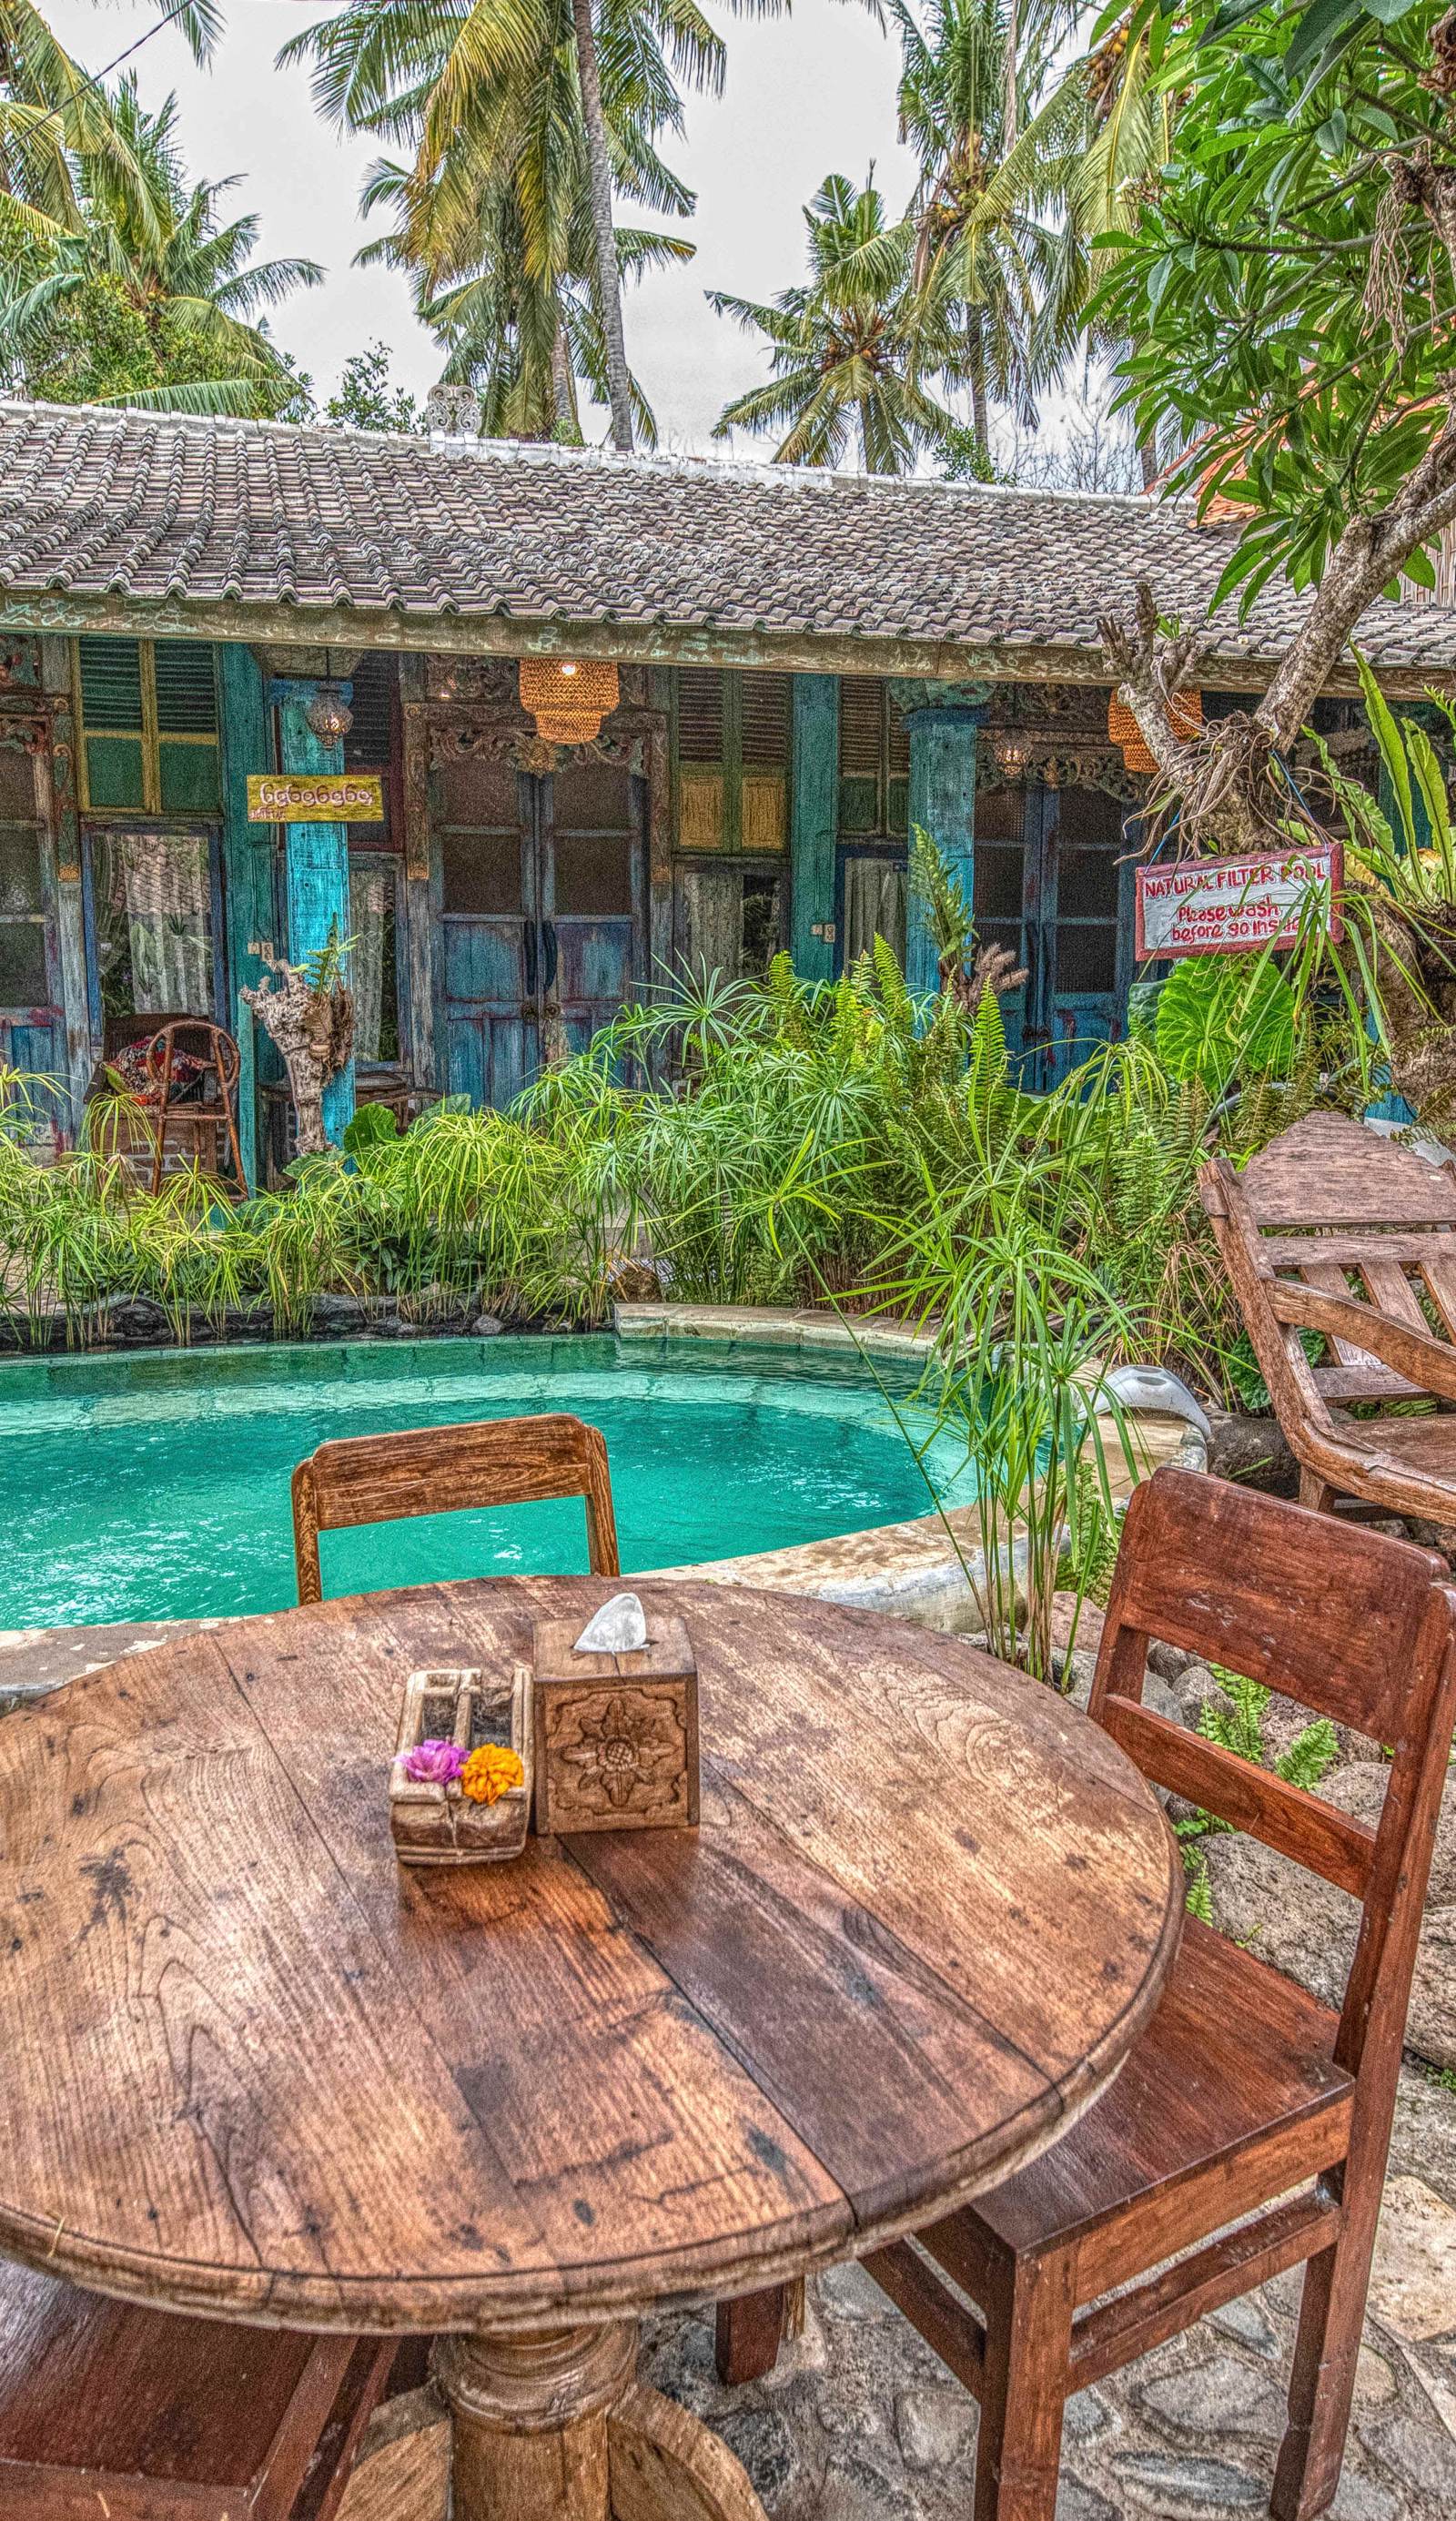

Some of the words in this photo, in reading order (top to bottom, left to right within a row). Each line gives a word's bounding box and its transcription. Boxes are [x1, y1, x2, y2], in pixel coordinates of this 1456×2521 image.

[1145, 875, 1215, 898] NATURAL
[1217, 866, 1275, 888] FILTER
[1178, 905, 1227, 923] Please
[1228, 893, 1279, 917] wash
[1172, 924, 1223, 944] before
[1228, 921, 1249, 938] go
